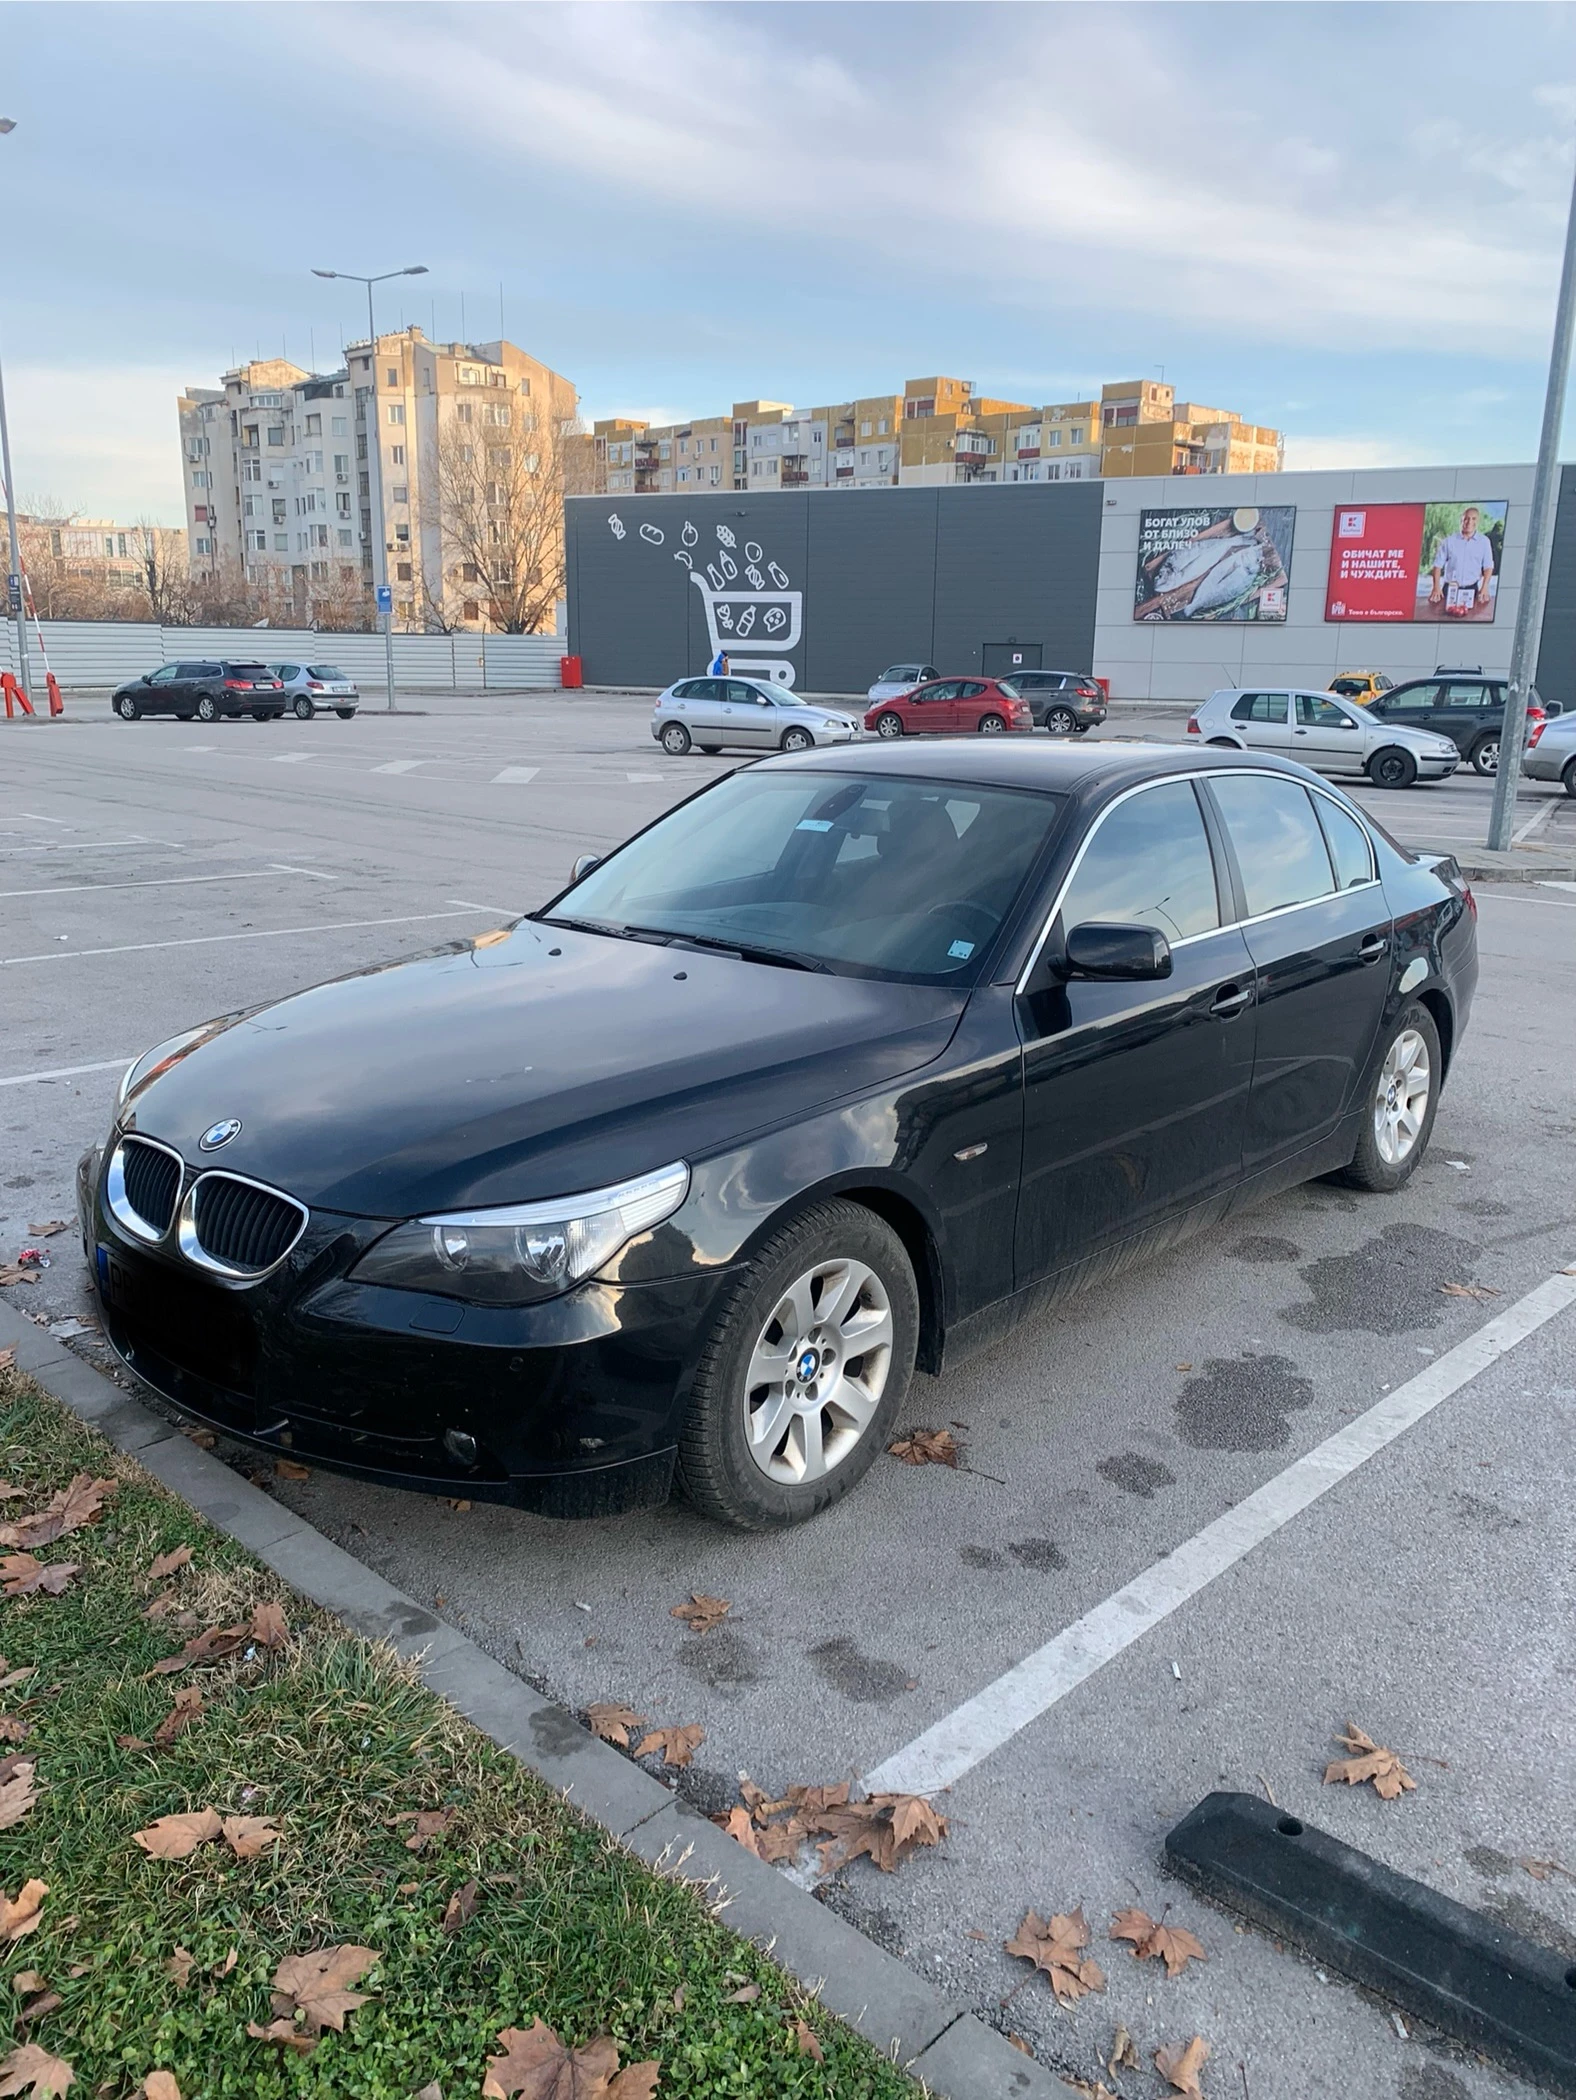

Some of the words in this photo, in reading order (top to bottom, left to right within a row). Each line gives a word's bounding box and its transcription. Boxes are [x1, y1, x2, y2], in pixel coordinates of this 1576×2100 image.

[1145, 517, 1179, 528] БОГАТ
[1180, 516, 1211, 527] УЛОВ
[1144, 529, 1160, 539] ОТ
[1161, 528, 1199, 539] БЛИЗО
[1143, 541, 1152, 550] И
[1152, 540, 1192, 552] ДАЛЕЧ
[1342, 549, 1386, 559] ОБИЧАТ
[1388, 549, 1405, 559] МЕ
[1341, 559, 1350, 569] И
[1351, 559, 1401, 570] НАШИТЕ,
[1340, 569, 1349, 579] И
[1350, 569, 1408, 580] ЧУЖДИТЕ.
